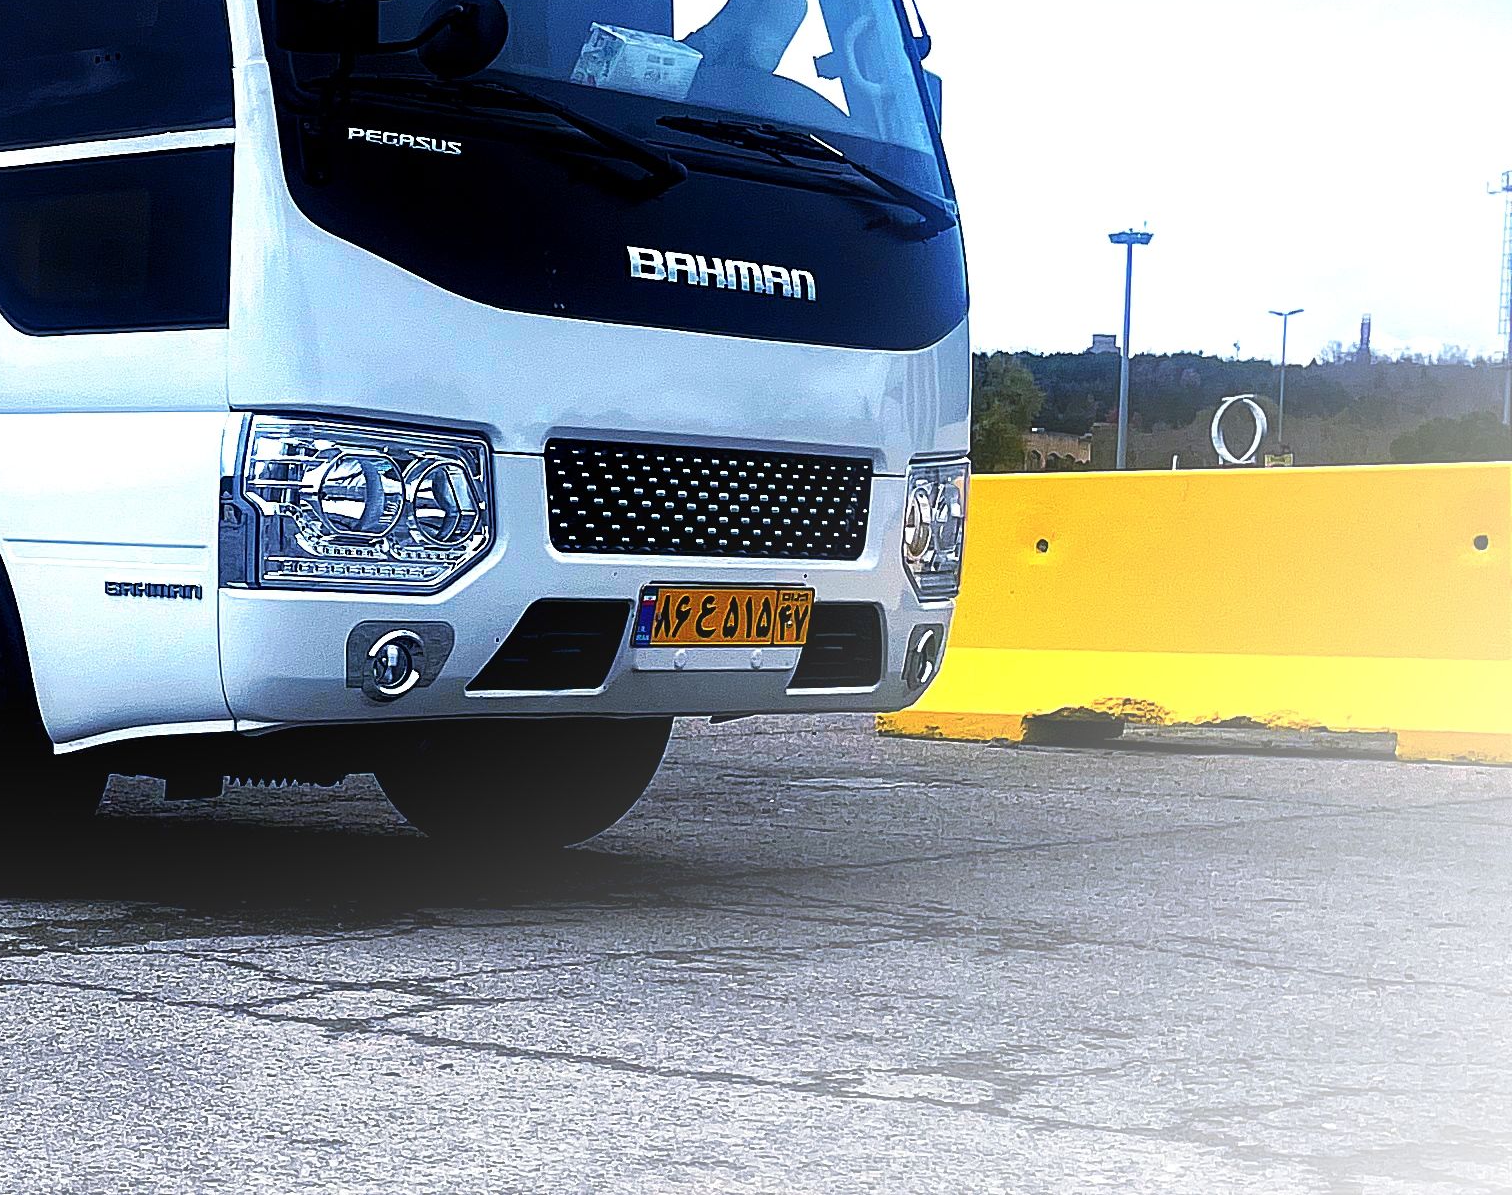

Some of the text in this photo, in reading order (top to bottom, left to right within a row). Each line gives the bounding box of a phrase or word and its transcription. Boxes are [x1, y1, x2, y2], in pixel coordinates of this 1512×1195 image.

[348, 127, 462, 155] PEGASUS
[627, 245, 816, 301] BAHMAN
[104, 581, 203, 600] BAHMAN
